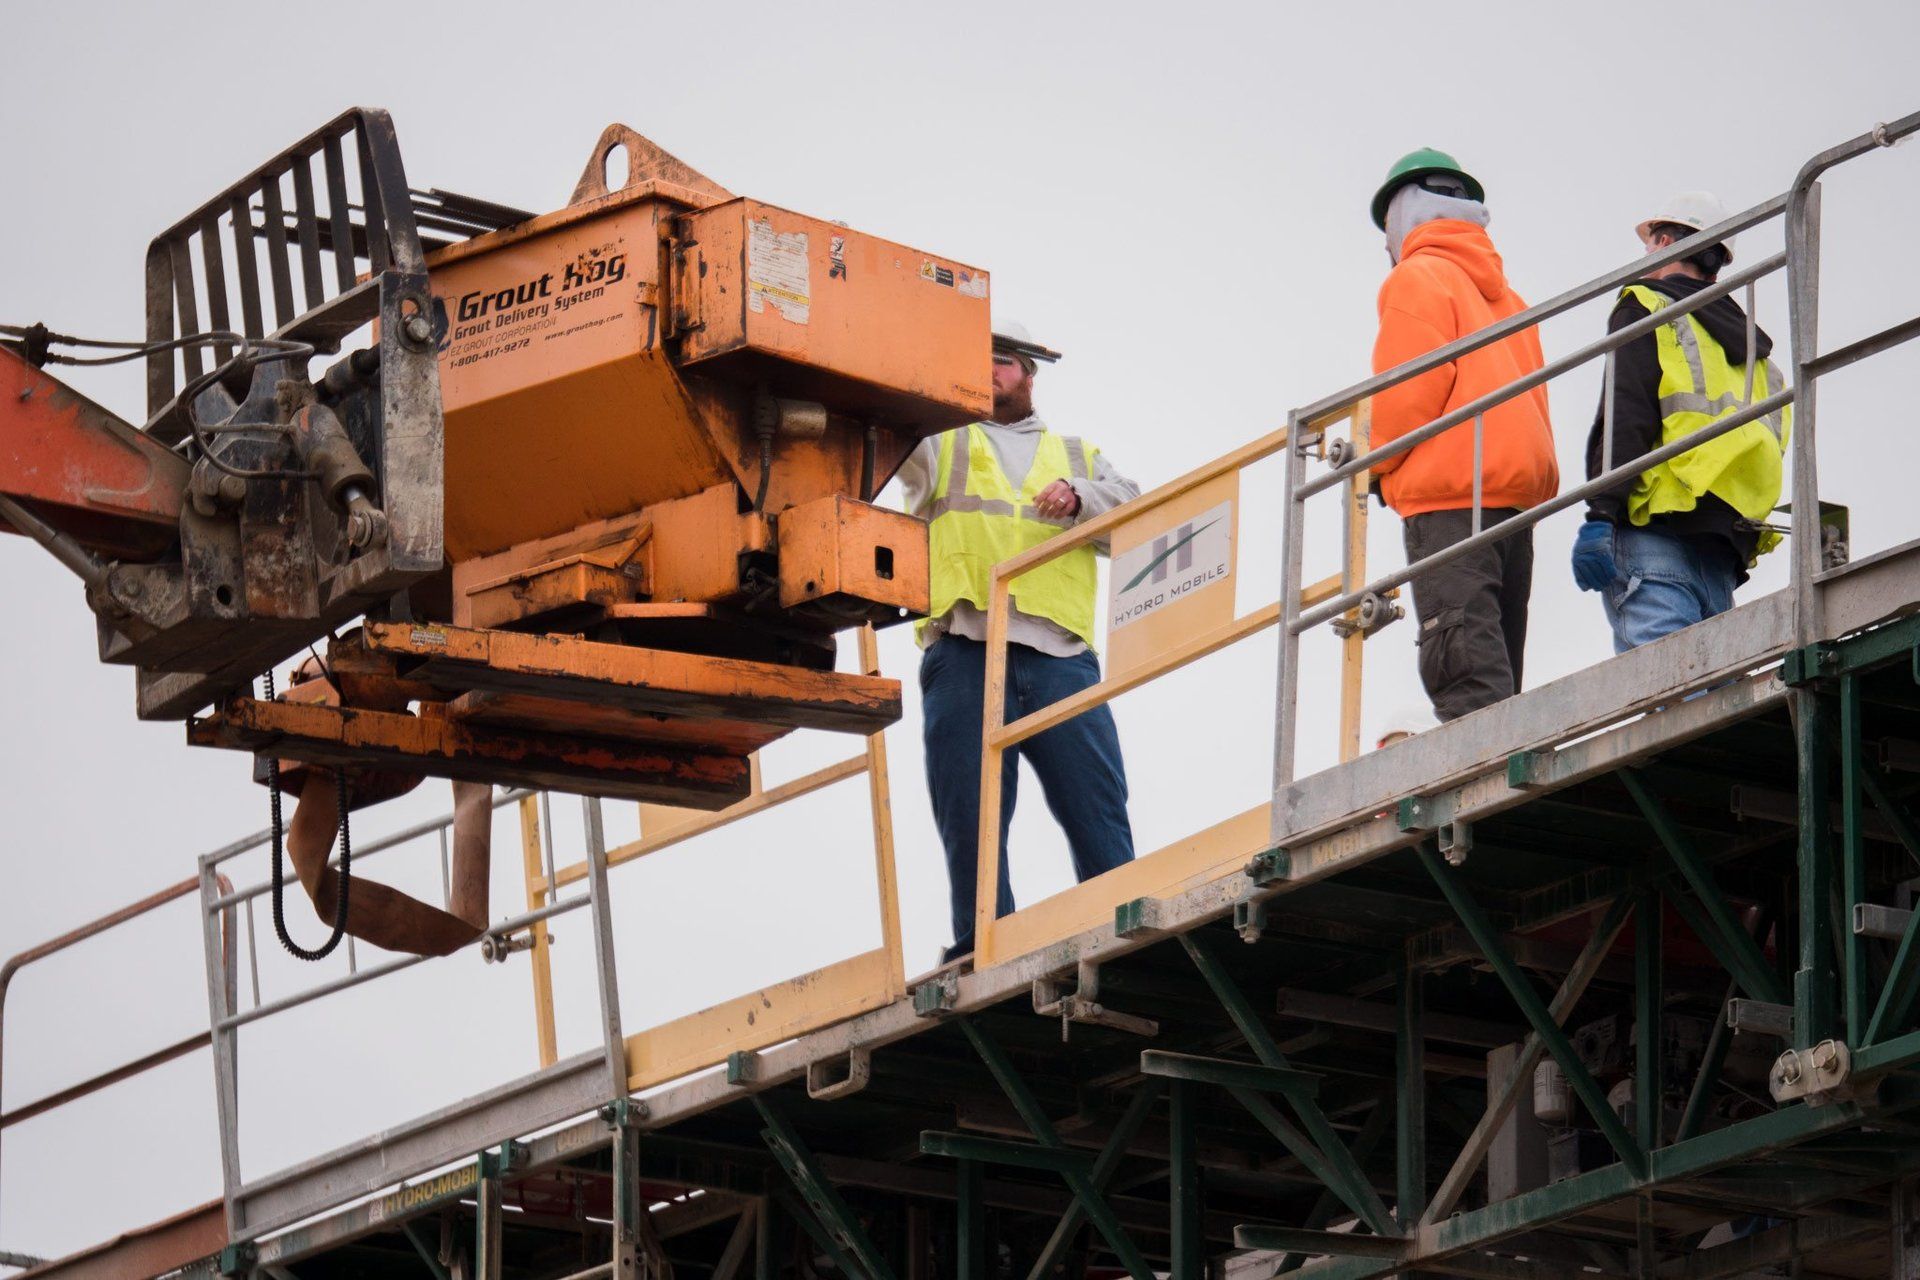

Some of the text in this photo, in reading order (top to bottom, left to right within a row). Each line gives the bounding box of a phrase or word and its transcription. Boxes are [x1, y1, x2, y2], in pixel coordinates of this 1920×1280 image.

[458, 253, 627, 322] Grout Hog
[450, 316, 557, 357] EZ GROUT CORPORATION
[455, 287, 604, 340] Grout Delivery System
[544, 313, 623, 341] www.grouthog.com
[449, 338, 530, 370] 1-800-417-9272
[1114, 563, 1225, 626] HYDRO MOBILE
